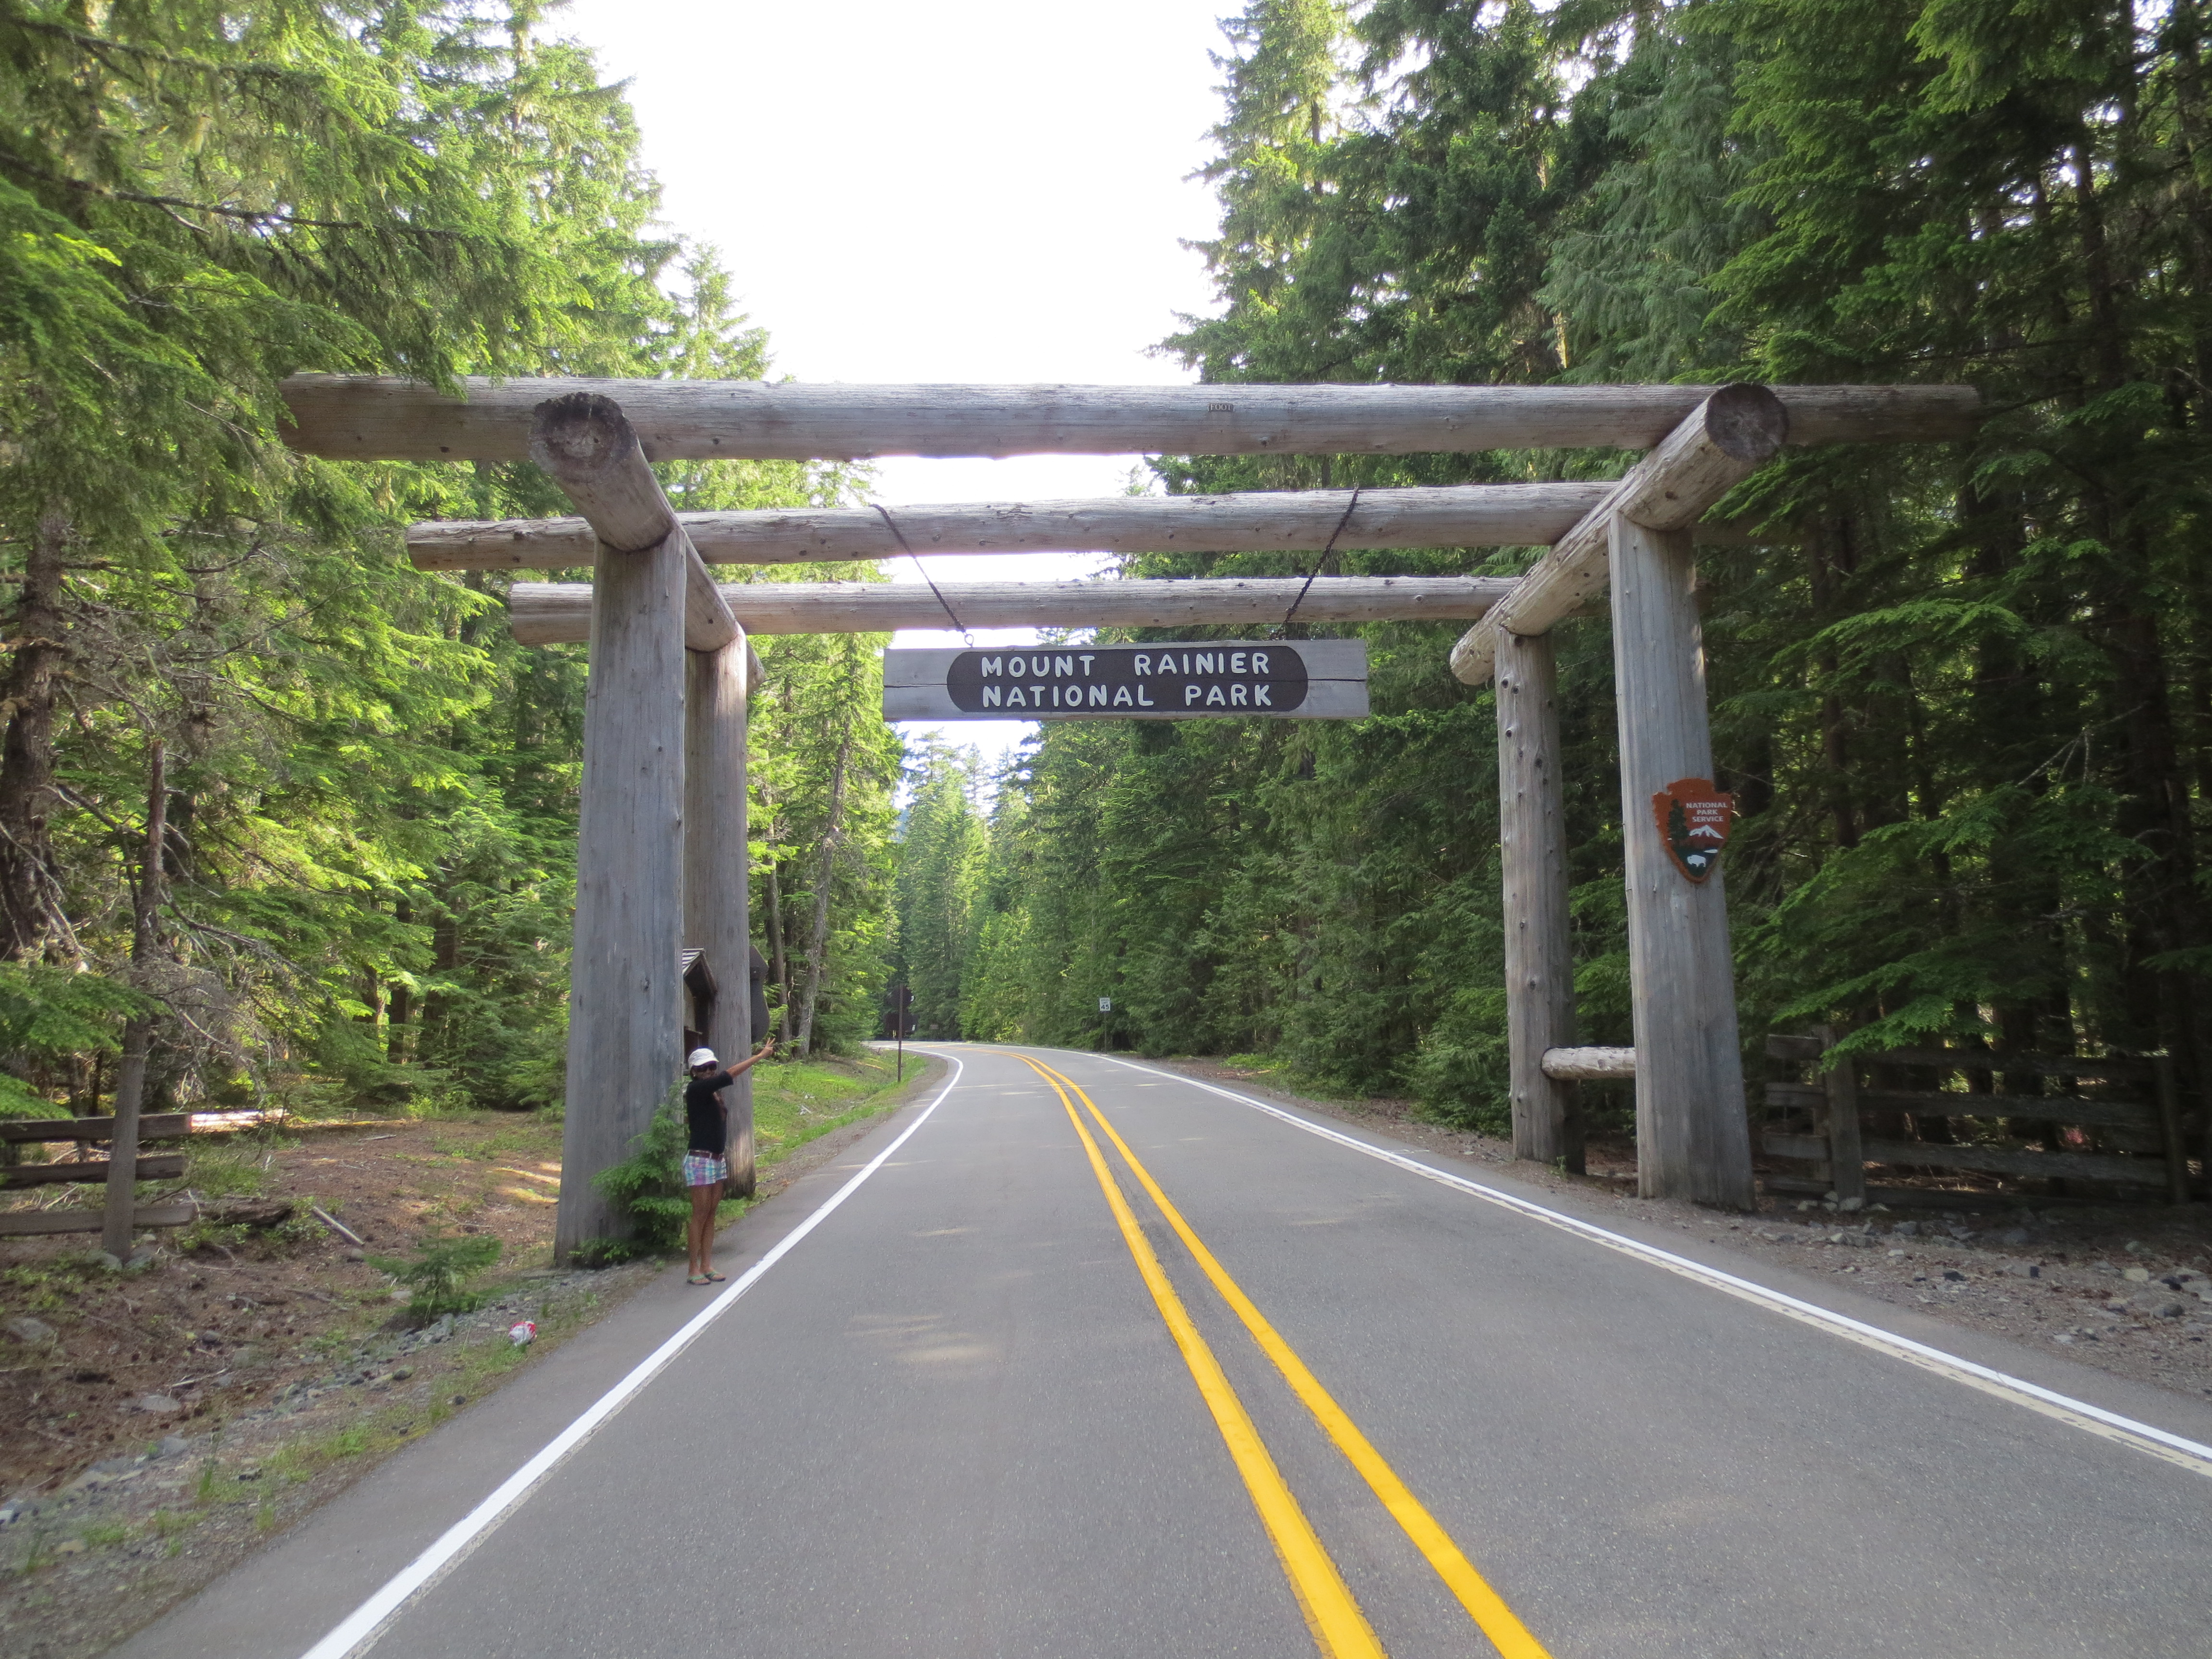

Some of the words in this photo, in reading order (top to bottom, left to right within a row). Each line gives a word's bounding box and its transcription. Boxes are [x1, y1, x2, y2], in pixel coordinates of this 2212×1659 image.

[981, 655, 1095, 677] MOUNT
[1134, 652, 1269, 675] RAINIER
[983, 684, 1154, 708] NATIONAL
[1185, 684, 1272, 706] PARK
